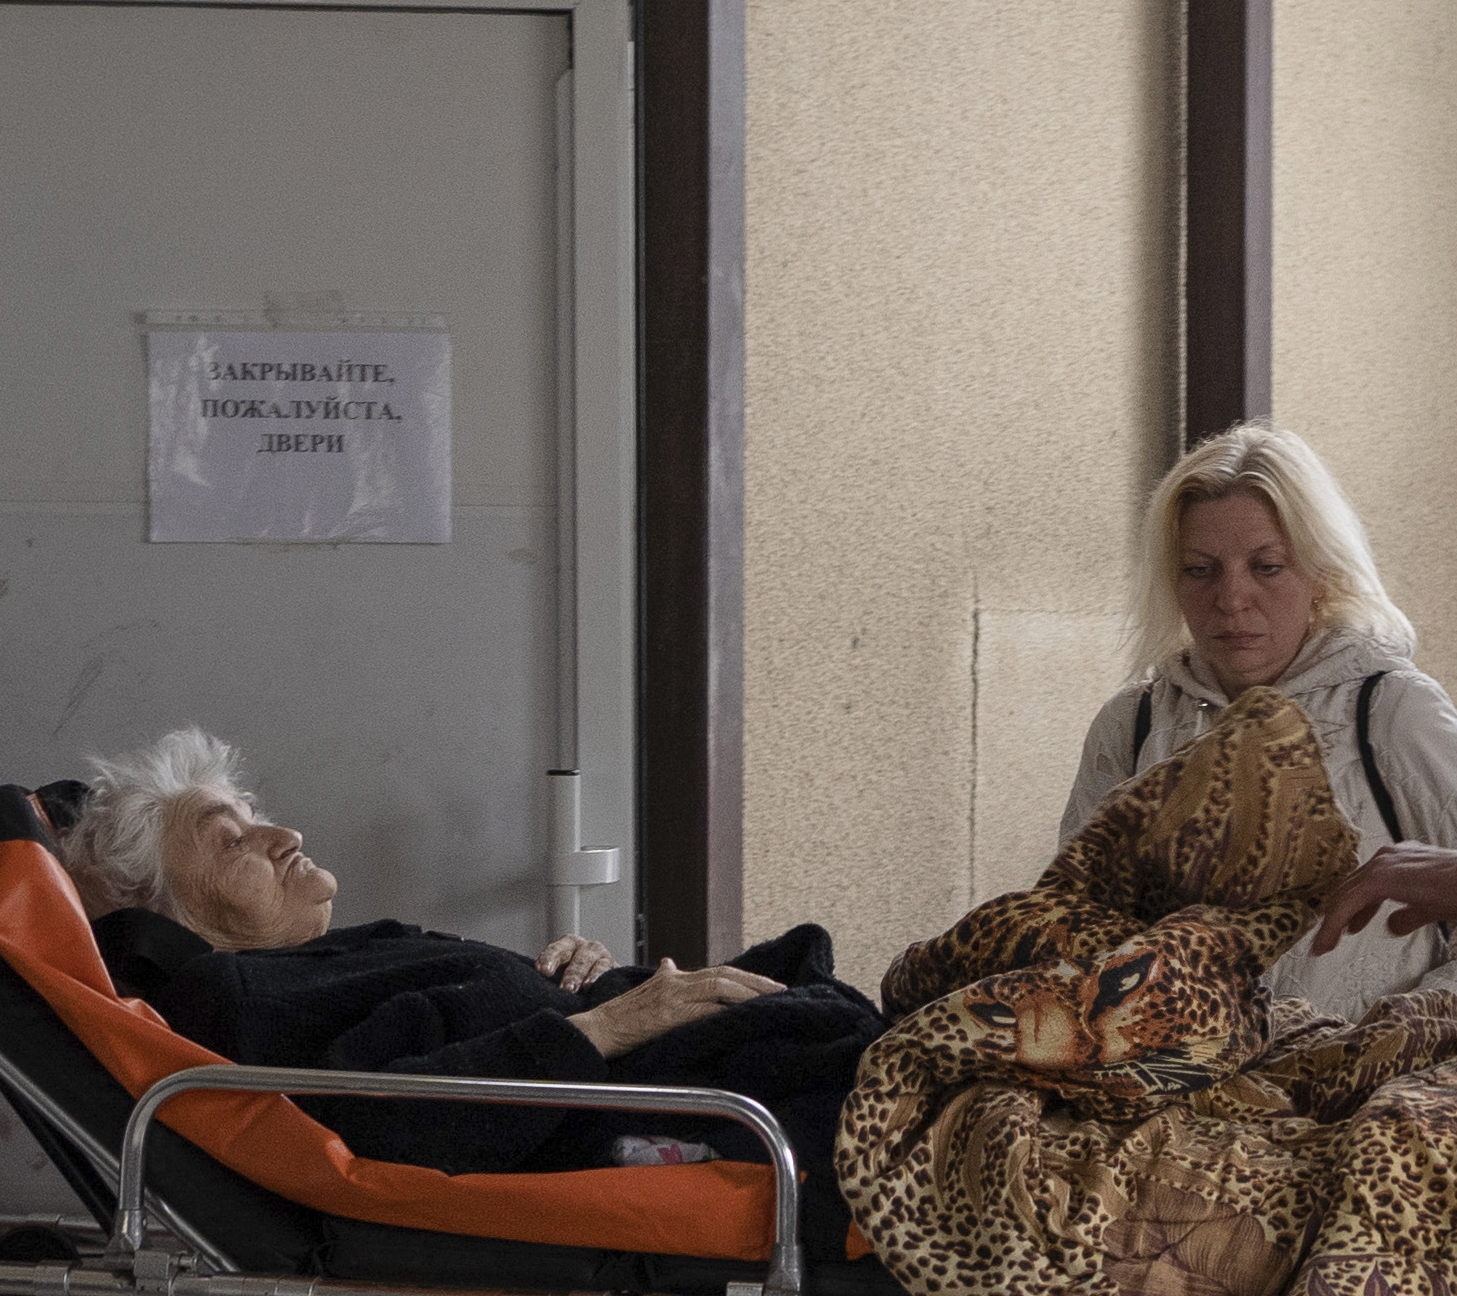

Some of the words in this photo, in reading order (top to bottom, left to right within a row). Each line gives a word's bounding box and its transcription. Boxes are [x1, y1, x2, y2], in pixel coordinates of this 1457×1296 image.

[207, 359, 395, 383] ЗАКРЫВАЙТЕ,
[201, 396, 403, 422] ПОЖАЛУЙСТА,
[256, 433, 345, 454] ДВЕРИ
